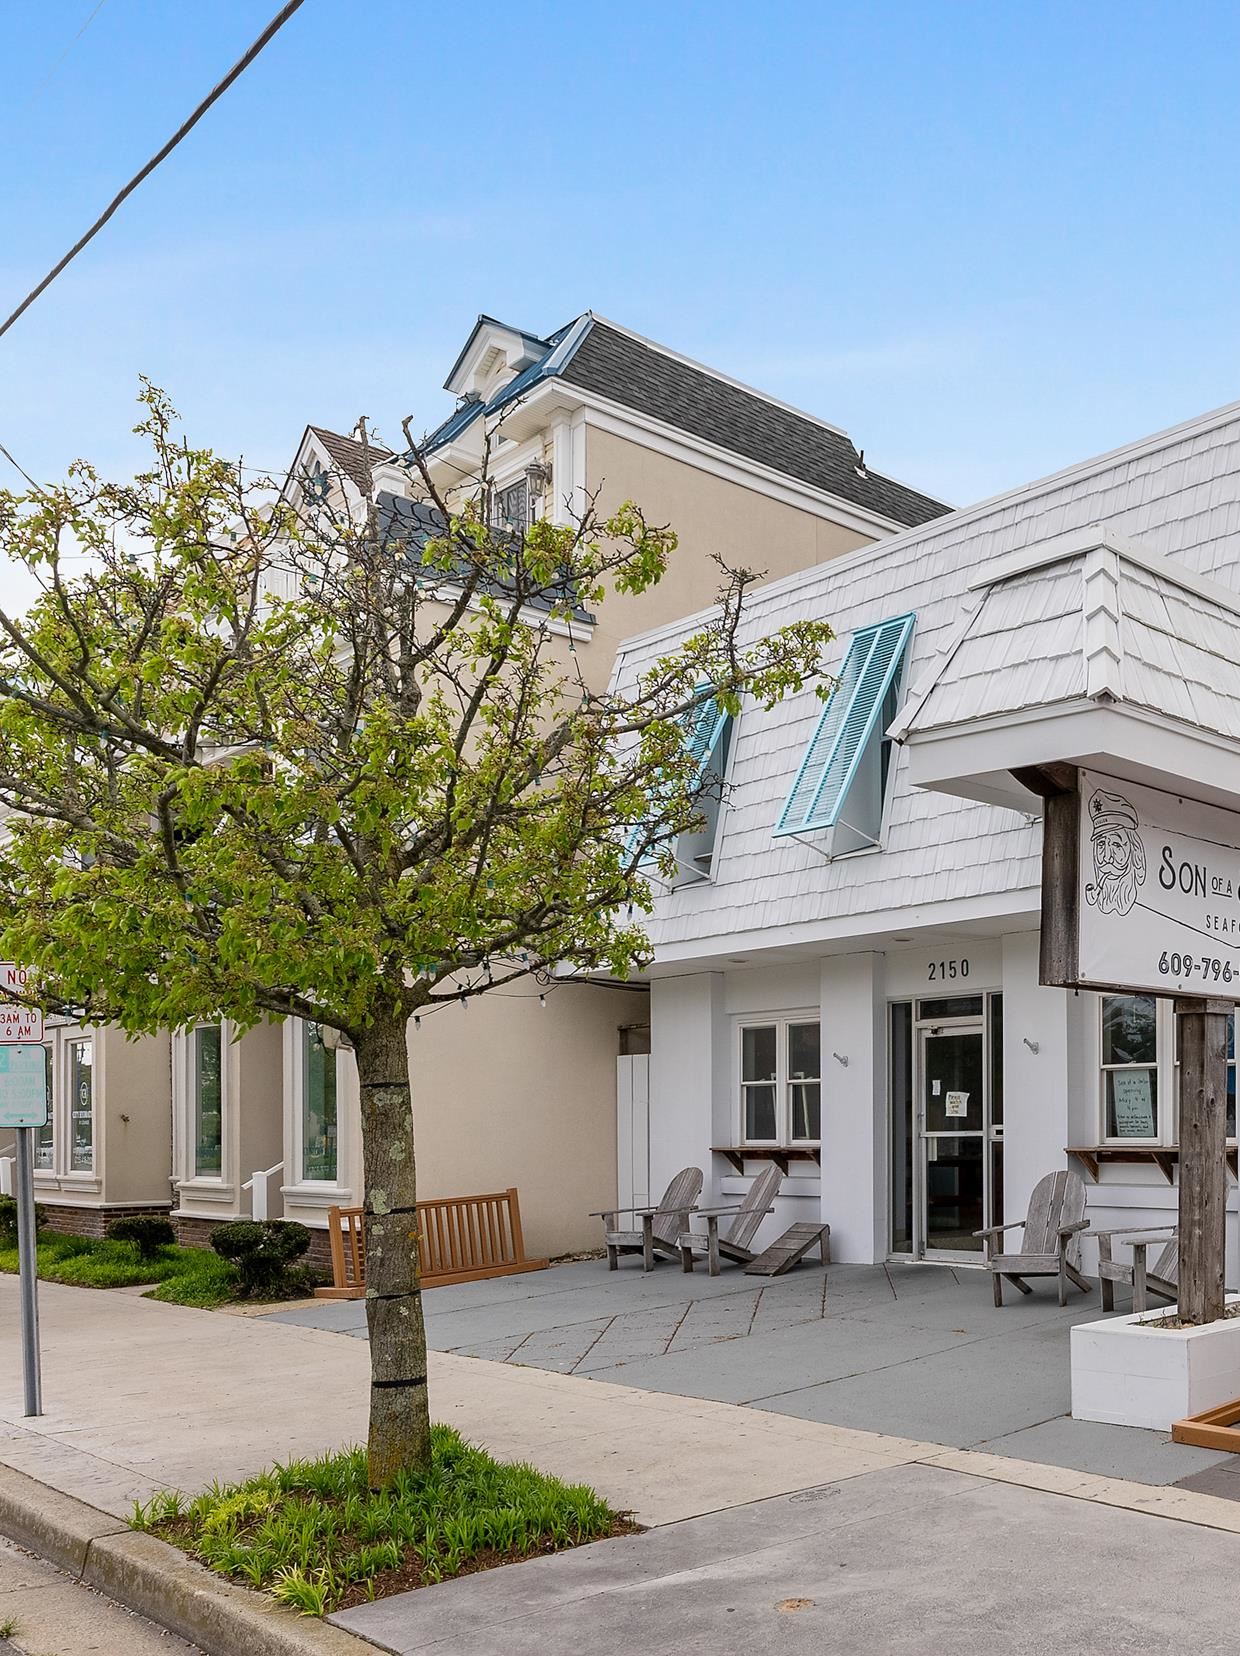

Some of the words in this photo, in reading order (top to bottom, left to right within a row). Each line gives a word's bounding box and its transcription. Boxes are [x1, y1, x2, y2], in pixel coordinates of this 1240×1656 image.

[1158, 845, 1207, 898] SON
[1211, 876, 1223, 894] OF
[1226, 879, 1233, 895] A
[7, 969, 27, 985] NO
[928, 958, 969, 981] 2150
[0, 1013, 20, 1024] 3AM
[25, 1013, 37, 1024] TO
[6, 1027, 12, 1036] 6
[18, 1027, 31, 1036] AM
